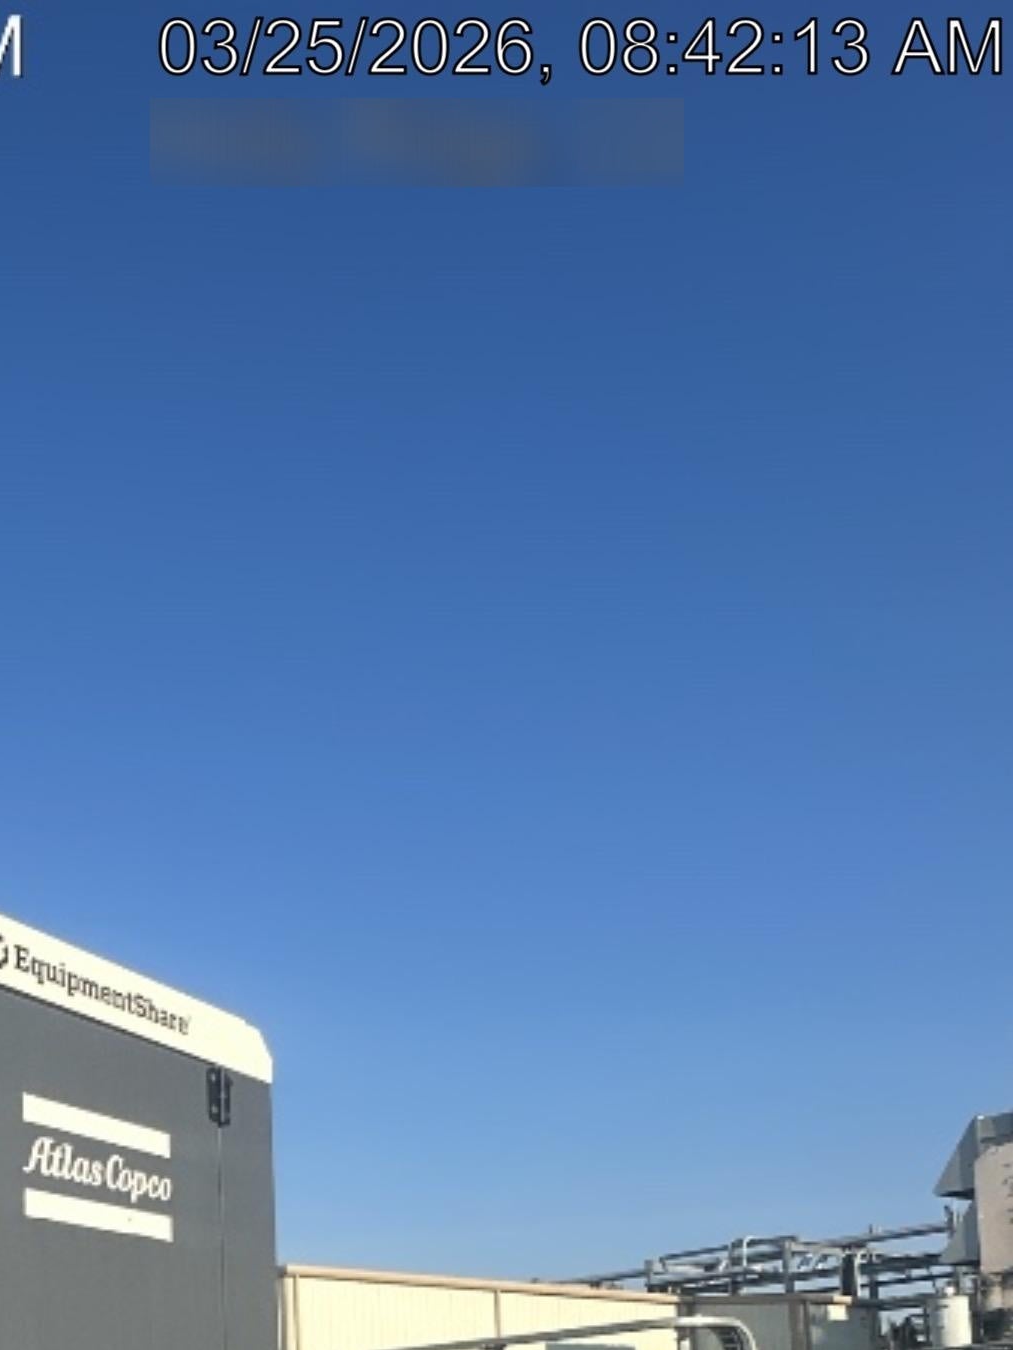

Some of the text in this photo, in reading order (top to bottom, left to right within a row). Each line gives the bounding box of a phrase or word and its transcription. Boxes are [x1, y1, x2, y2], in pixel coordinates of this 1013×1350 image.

[14, 943, 191, 1035] EquipmentShare
[22, 1136, 172, 1204] Atlas Copco
